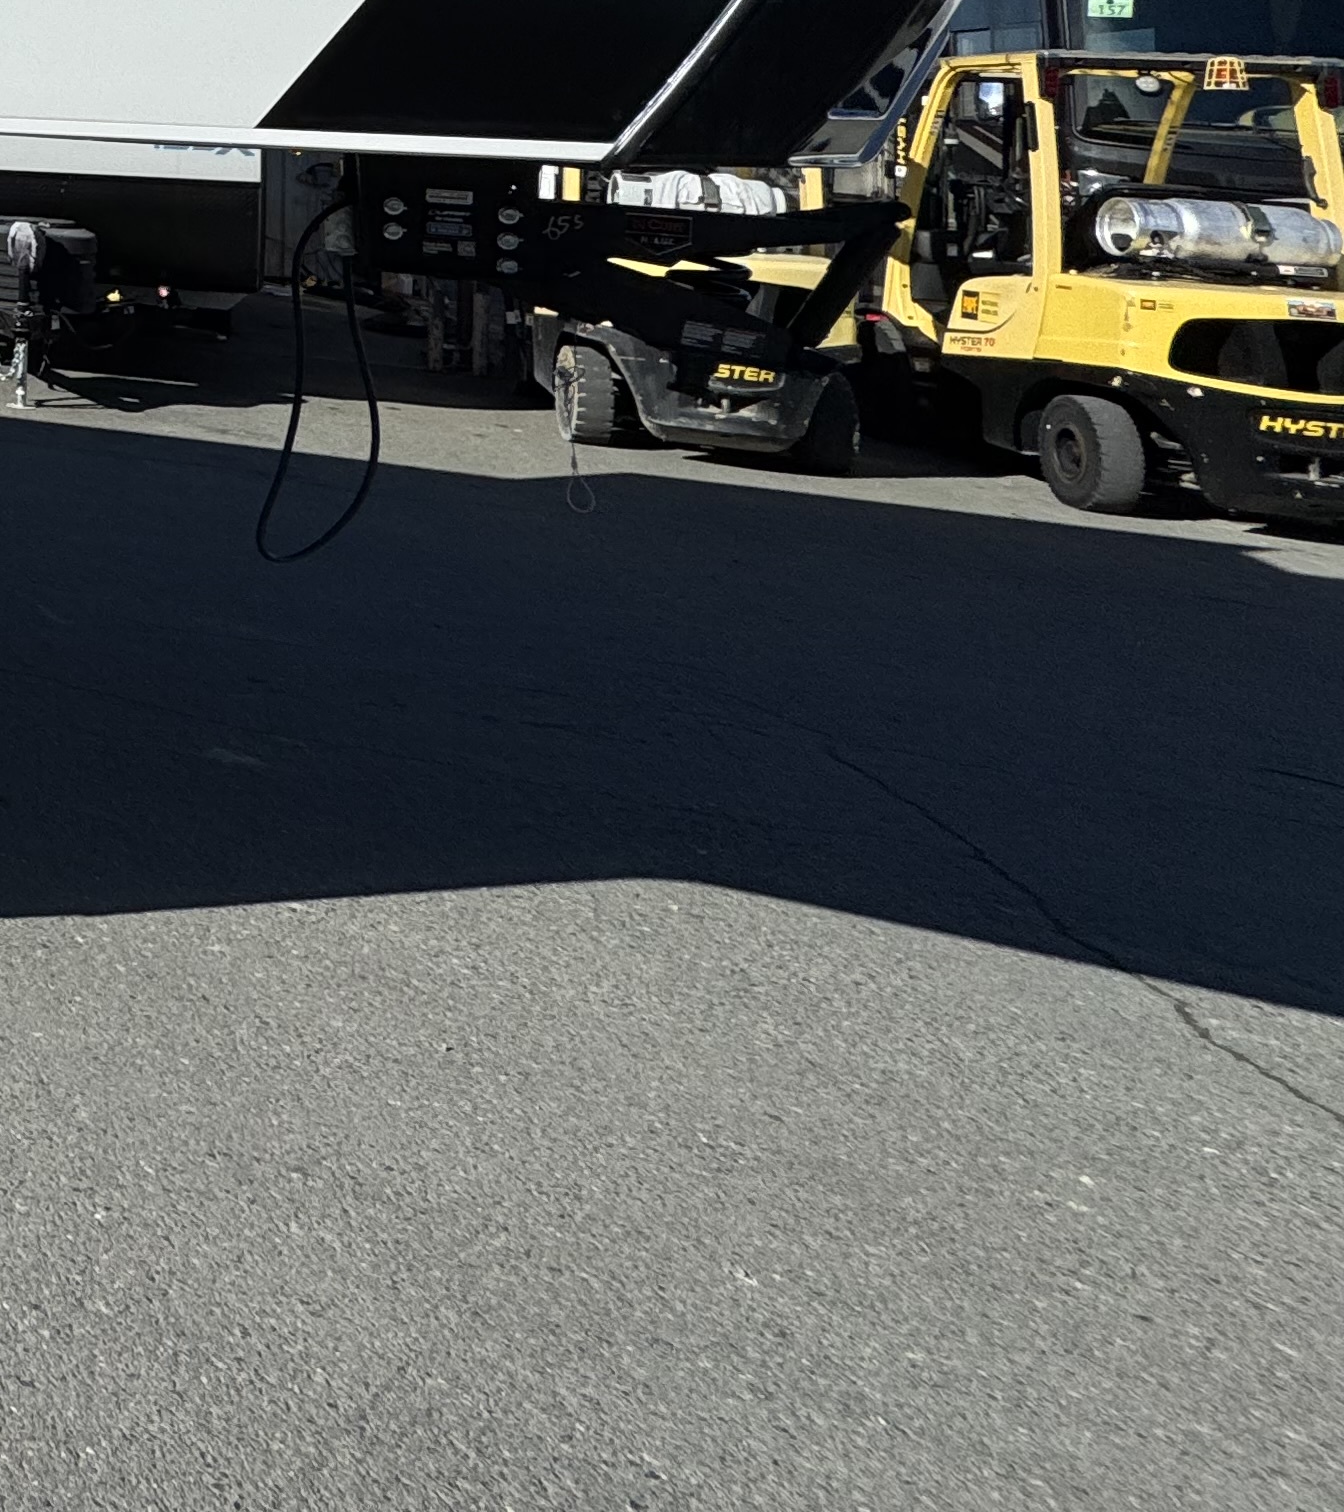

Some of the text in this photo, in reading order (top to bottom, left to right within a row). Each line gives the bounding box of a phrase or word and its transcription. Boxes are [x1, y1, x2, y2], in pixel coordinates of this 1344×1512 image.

[949, 336, 982, 346] HYSTER
[713, 363, 777, 384] STER
[1258, 415, 1344, 440] HYST
